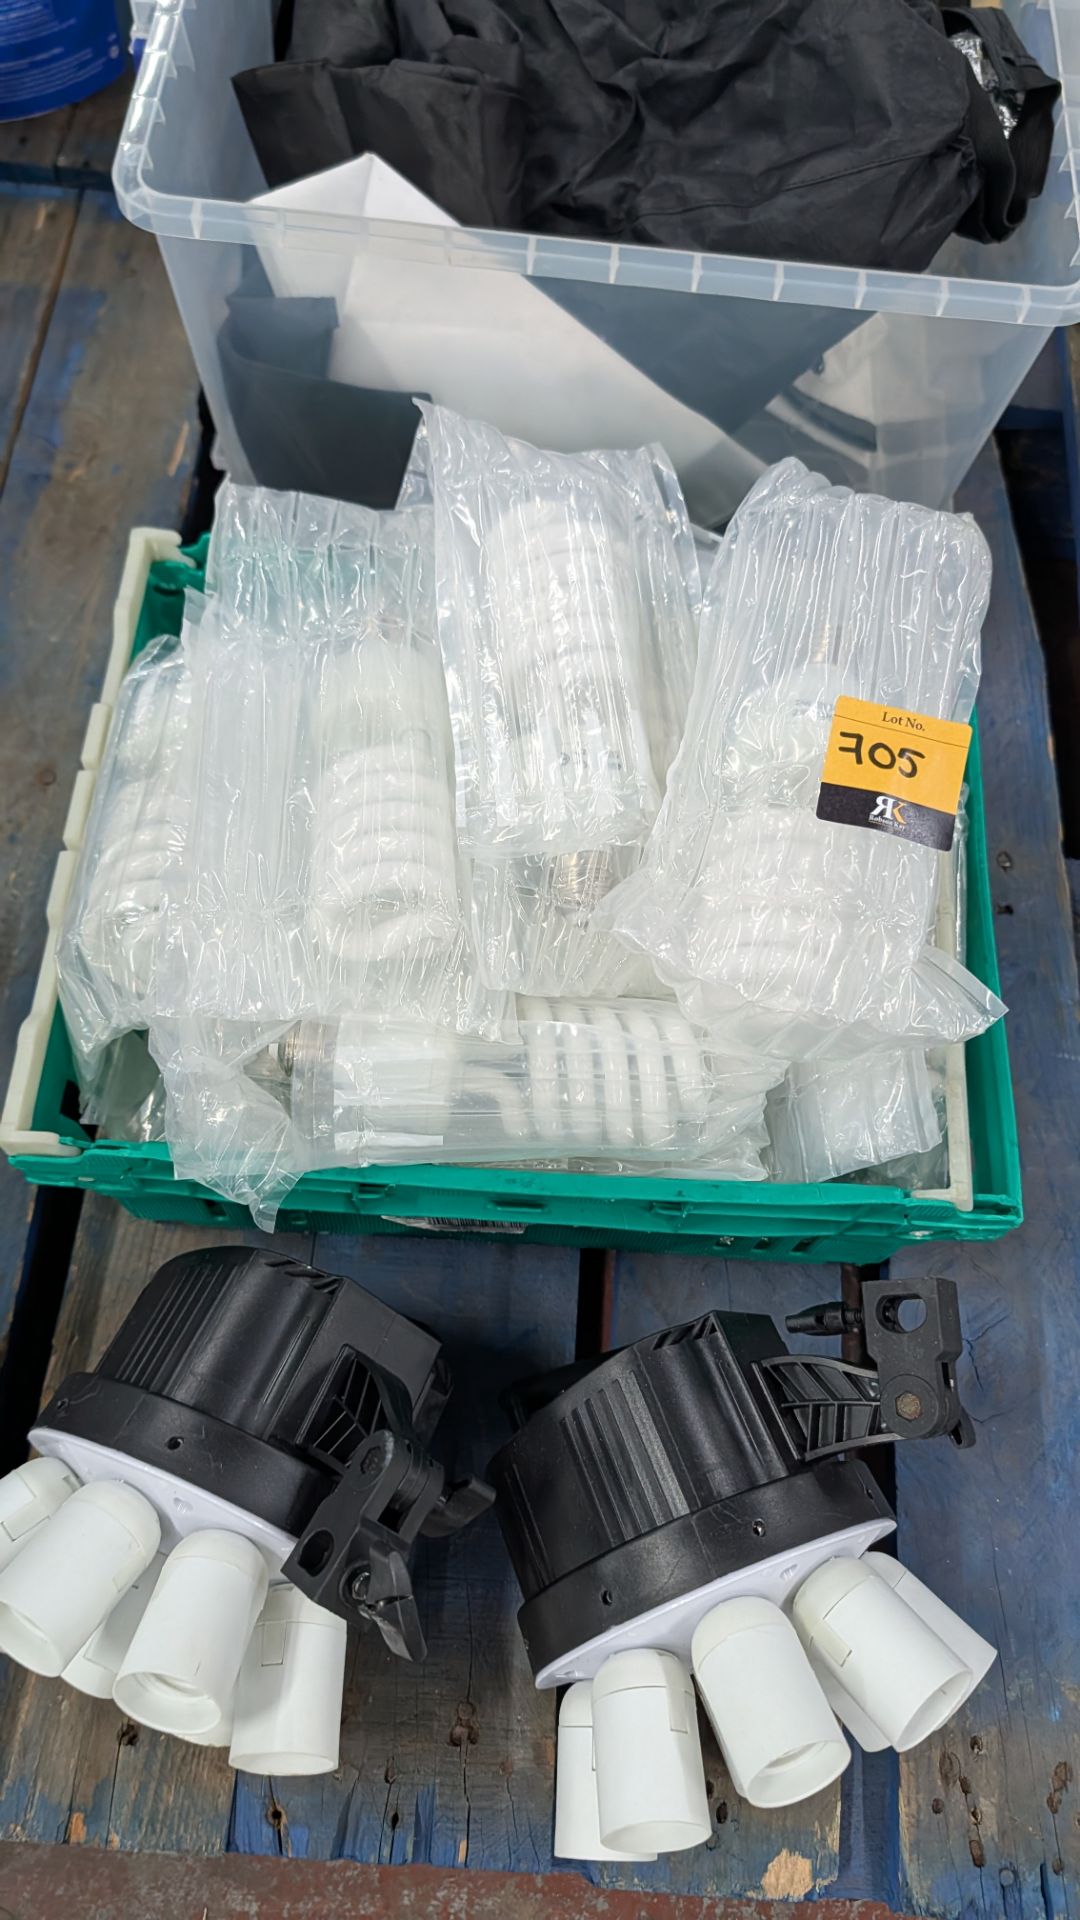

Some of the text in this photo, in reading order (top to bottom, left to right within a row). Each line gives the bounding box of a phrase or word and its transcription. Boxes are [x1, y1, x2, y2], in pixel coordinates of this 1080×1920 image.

[882, 711, 926, 732] Lot No.
[838, 731, 926, 779] 705
